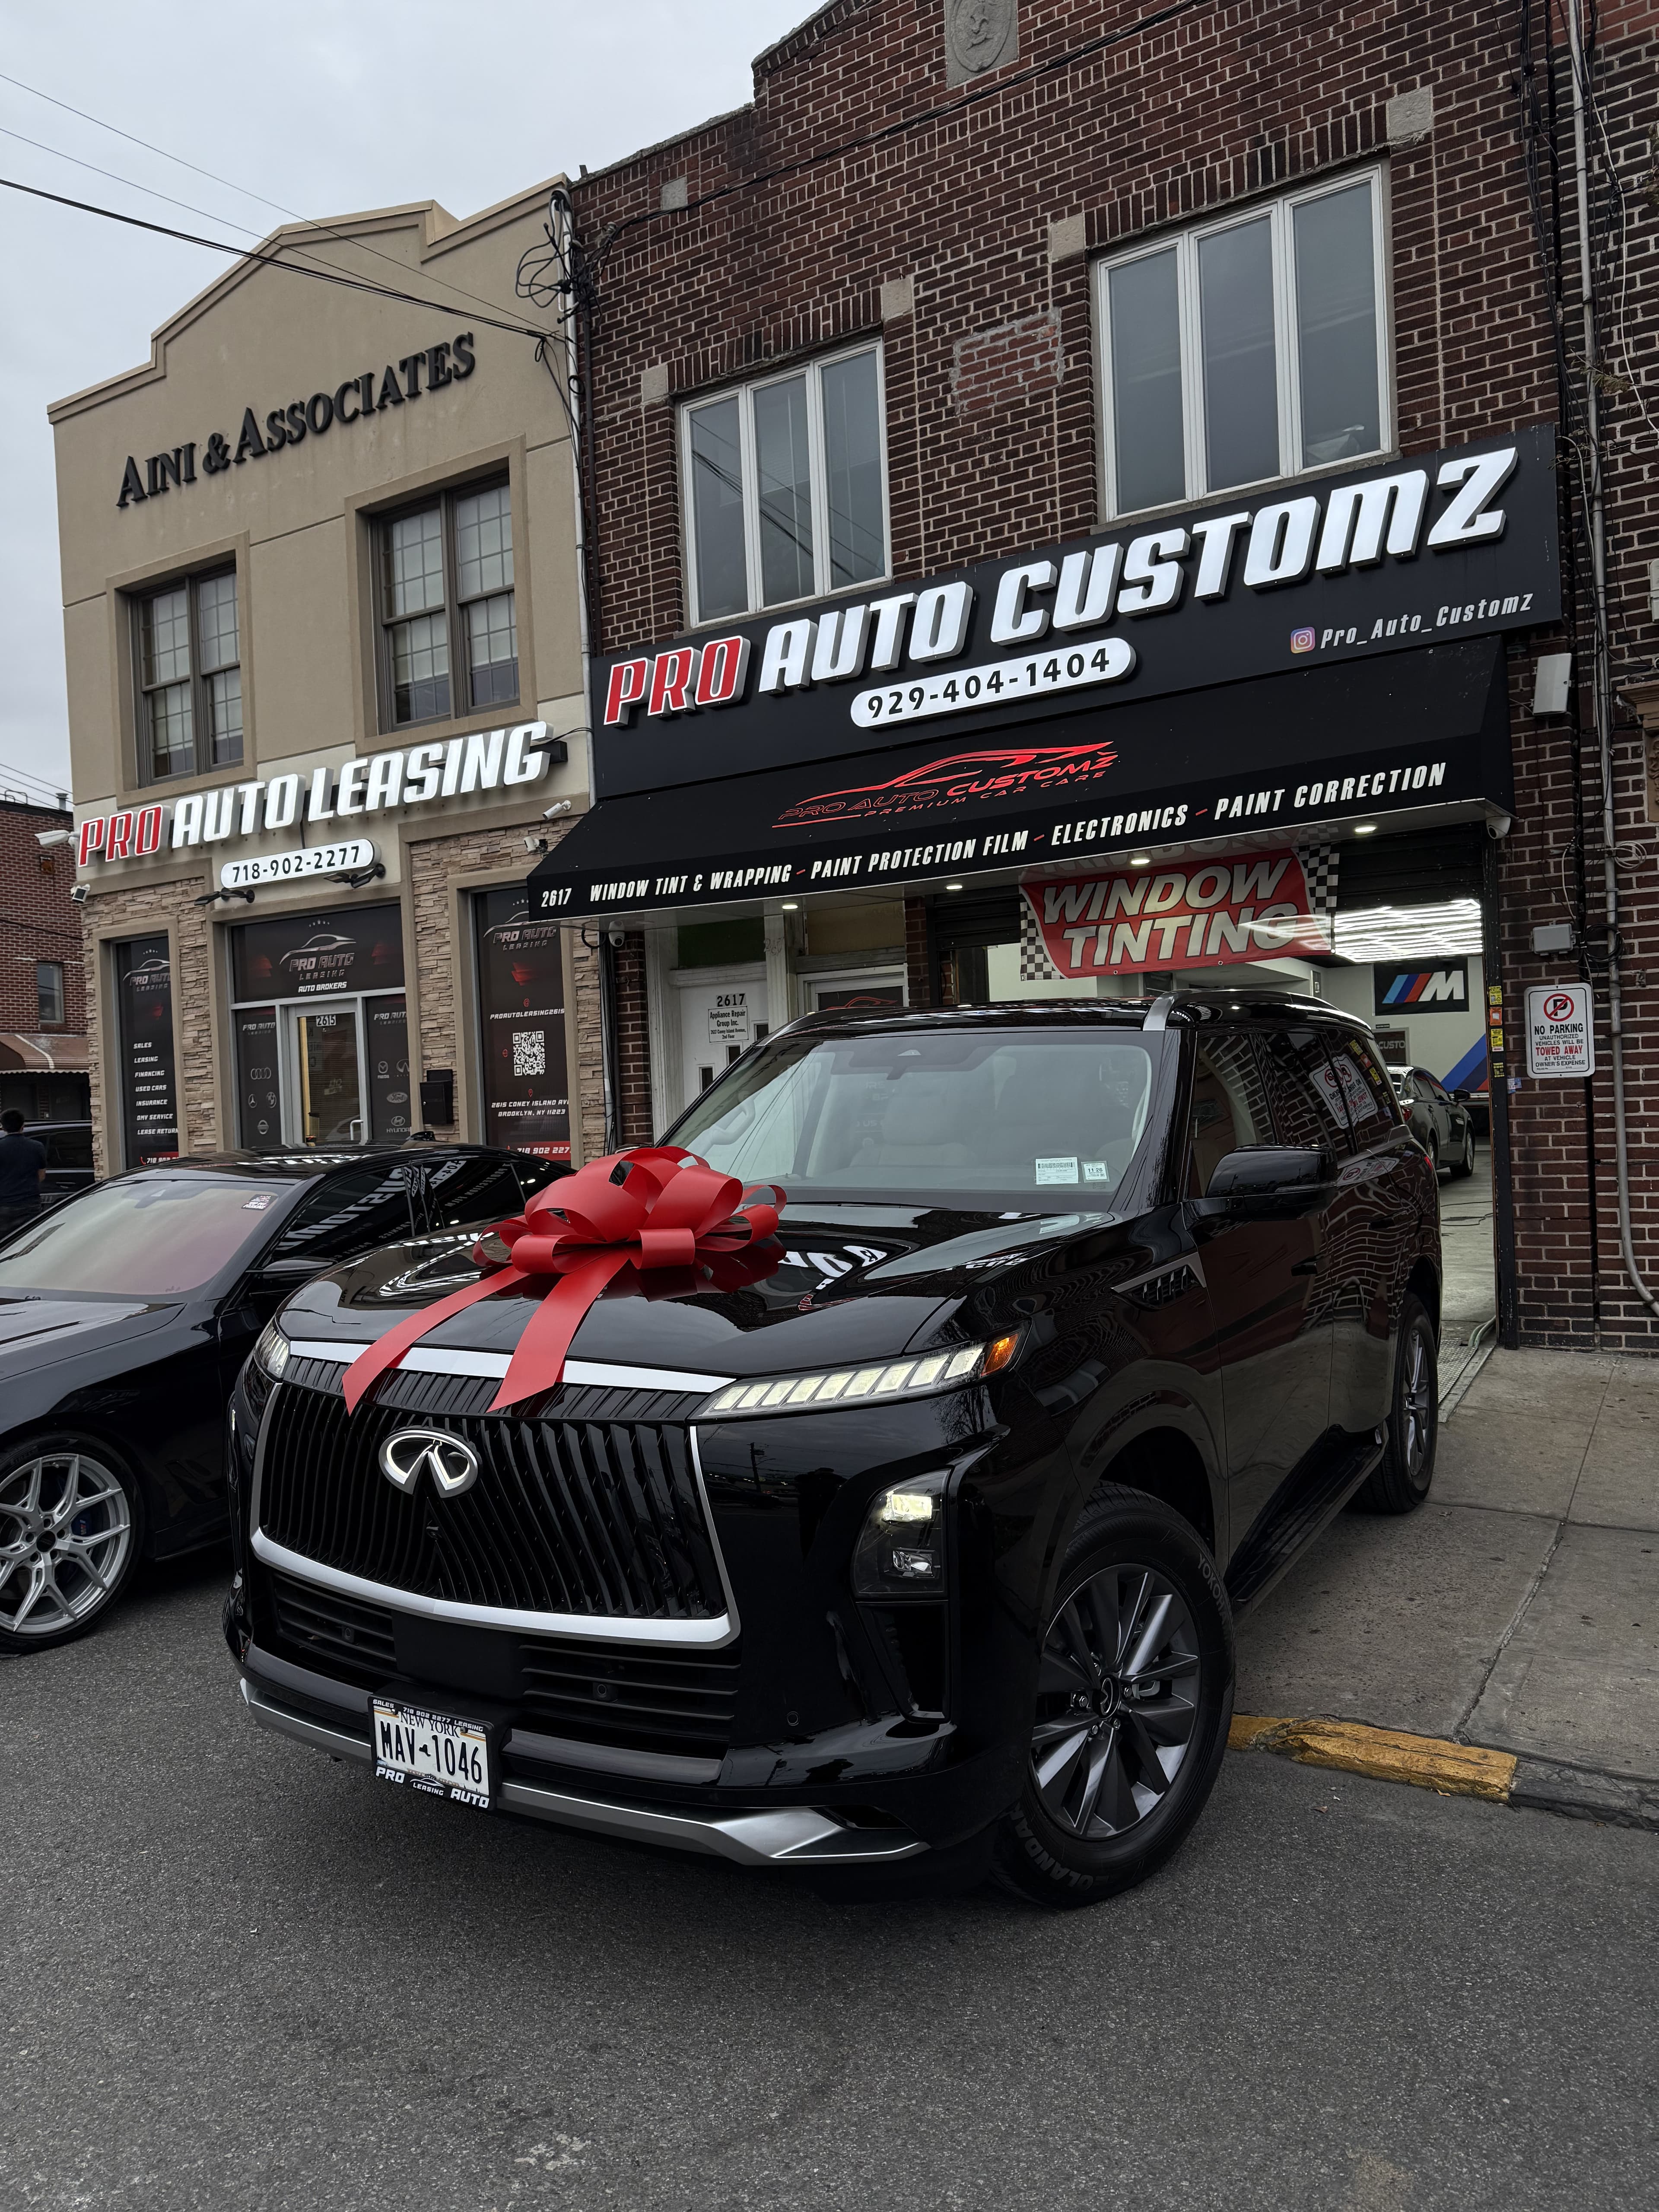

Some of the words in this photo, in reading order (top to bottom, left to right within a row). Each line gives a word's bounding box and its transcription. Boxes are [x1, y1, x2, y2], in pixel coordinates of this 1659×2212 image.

[116, 442, 197, 508] AINI
[202, 432, 231, 474] &
[232, 332, 476, 464] ASSOCIATES
[603, 635, 751, 728] PRO
[758, 581, 973, 694] AUTO
[990, 447, 1517, 646] CUSTOMZ
[868, 648, 1110, 718] 929-404-1404
[78, 804, 172, 867] PRO
[172, 773, 307, 849] AUTO
[307, 721, 554, 822] LEASING
[779, 801, 846, 820] PRO
[848, 788, 940, 811] AUTO
[947, 752, 1119, 797] CUSTOMZ
[864, 797, 966, 817] PREMIUM
[980, 787, 1027, 799] CAR
[1042, 772, 1106, 788] CARE
[590, 880, 649, 902] WINDOW
[655, 875, 689, 895] TINT
[693, 874, 703, 892] &
[710, 864, 792, 890] WRAPPING
[810, 855, 863, 879] PAINT
[867, 839, 977, 872] PROTECTION
[982, 830, 1029, 856] FILM
[1051, 804, 1189, 846] ELECTRONICS
[1214, 789, 1285, 820] PAINT
[1294, 762, 1446, 808] CORRECTION
[232, 845, 360, 884] 718-902-2277
[541, 888, 572, 907] 2617
[1043, 858, 1293, 925] WINDOW
[493, 931, 520, 944] PRO
[522, 926, 556, 940] AUTO
[1062, 902, 1298, 969] TINTING
[503, 940, 547, 951] LEASING
[289, 957, 316, 972] PRO
[318, 953, 354, 969] AUTO
[130, 975, 149, 986] PRO
[299, 969, 344, 980] LEASING
[298, 985, 315, 993] AUTO
[316, 982, 347, 991] BROKERS
[717, 993, 745, 1007] 2617
[317, 1015, 335, 1026] 2615
[490, 1008, 565, 1020] PROAUTOLEASING2615
[710, 1011, 730, 1020] Appliance
[731, 1010, 746, 1018] Repair
[257, 1022, 276, 1030] AUTO
[1535, 1026, 1545, 1035] NO
[1550, 1023, 1583, 1034] PARKING
[1535, 1046, 1560, 1056] TOWED
[1564, 1045, 1583, 1054] AWAY
[372, 1699, 394, 1708] SALES
[398, 1713, 425, 1729] NEW
[429, 1720, 460, 1738] YORK
[416, 1710, 430, 1719] 902
[432, 1714, 451, 1723] 2277
[454, 1719, 484, 1732] LEASING
[380, 1720, 415, 1765] MAV
[432, 1735, 482, 1784] 1046
[375, 1766, 405, 1784] PRO
[413, 1782, 444, 1796] LEASING
[451, 1788, 489, 1809] AUTO
